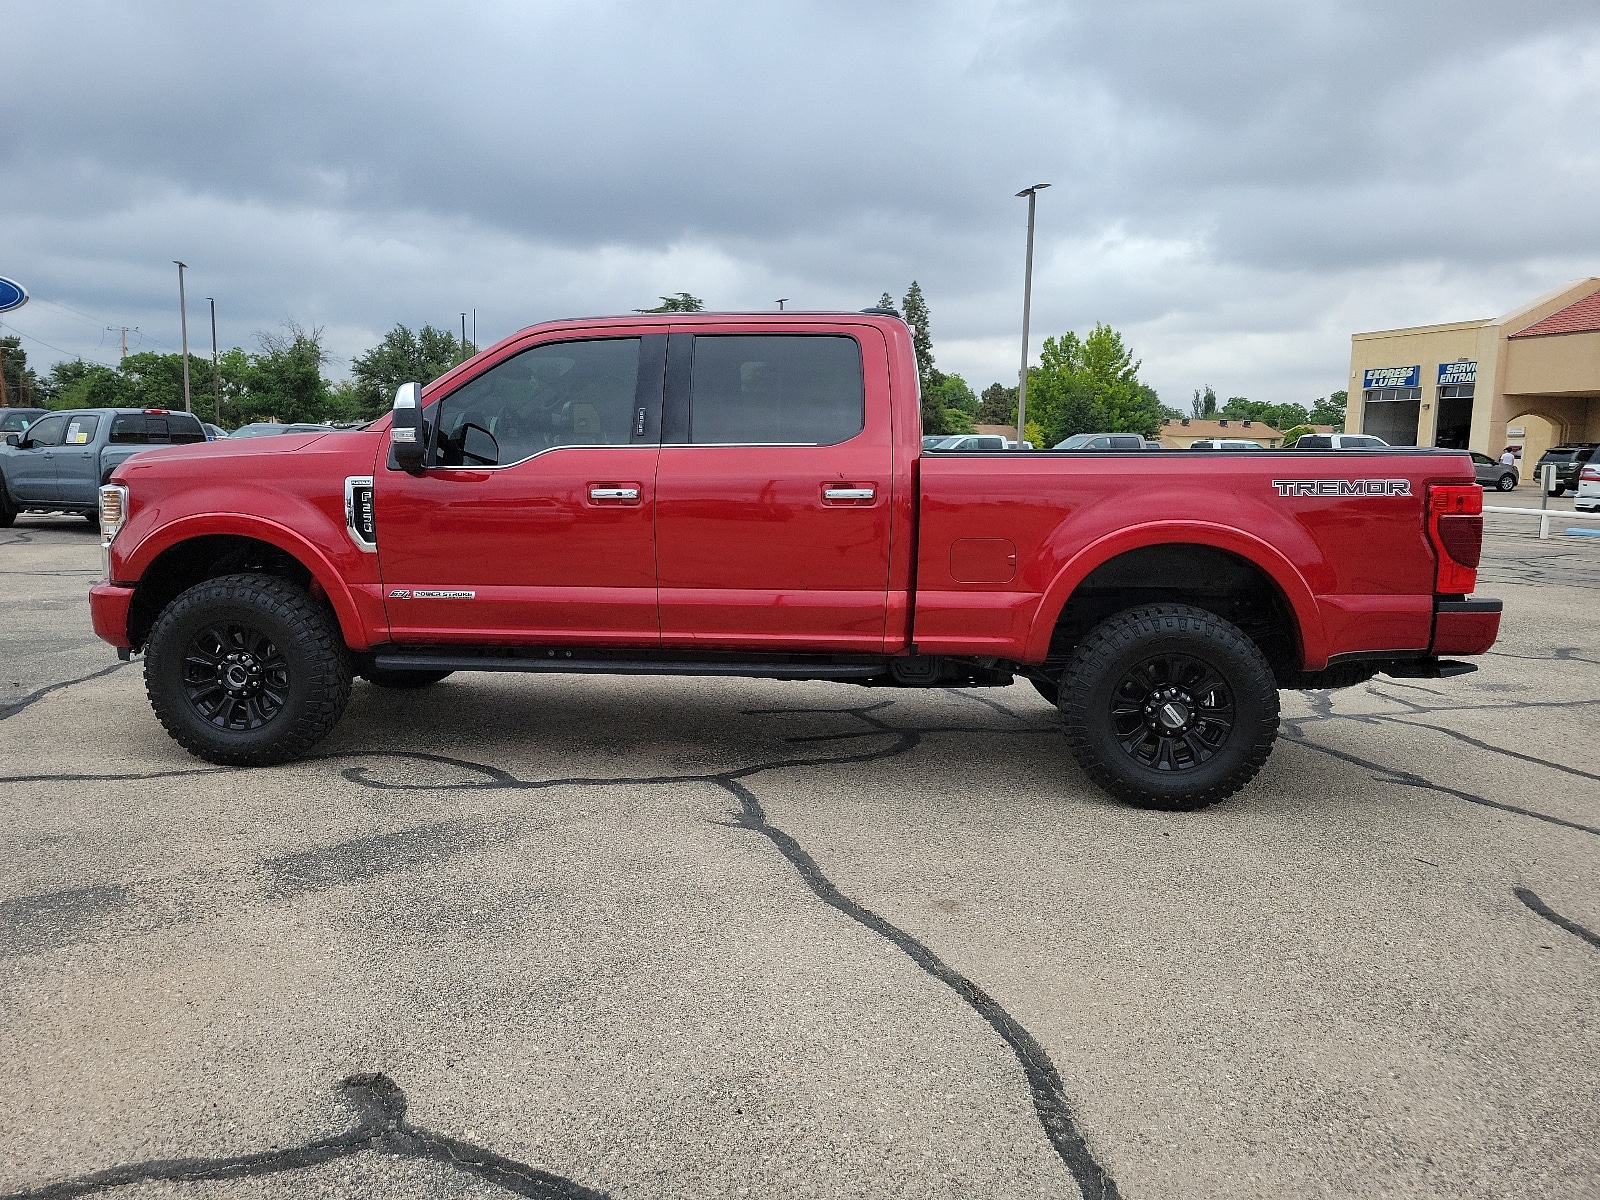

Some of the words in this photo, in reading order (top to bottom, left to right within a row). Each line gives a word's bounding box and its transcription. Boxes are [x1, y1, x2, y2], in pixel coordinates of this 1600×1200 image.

[1366, 367, 1414, 379] EXPRESS
[1445, 362, 1477, 373] SERVI
[1371, 377, 1406, 387] LUBE
[1272, 479, 1413, 496] TREMOR
